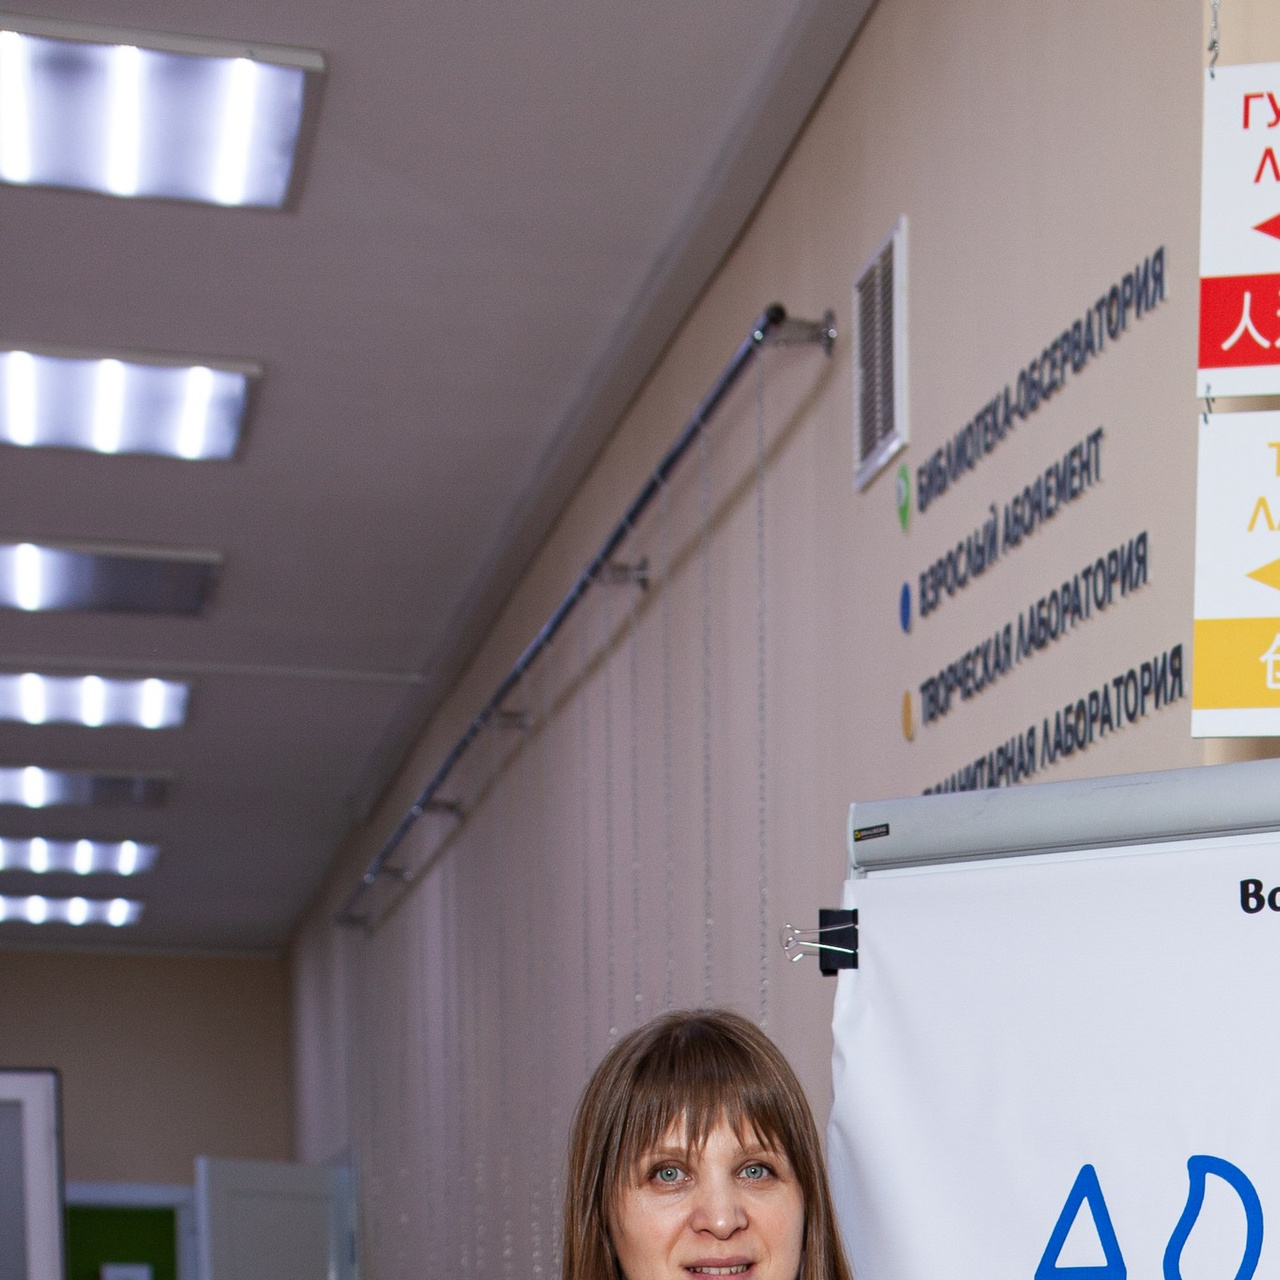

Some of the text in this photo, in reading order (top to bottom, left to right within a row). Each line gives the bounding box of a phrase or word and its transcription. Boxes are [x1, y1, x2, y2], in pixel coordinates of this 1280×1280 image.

[919, 426, 1105, 618] ВЗРОСЛЫЙ АБОНЕМЕНТ
[919, 531, 1150, 726] ТВОРЧЕСКАЯ ЛАБОРАТОРИЯ
[1040, 643, 1185, 769] ЛАБОРАТОРИЯ
